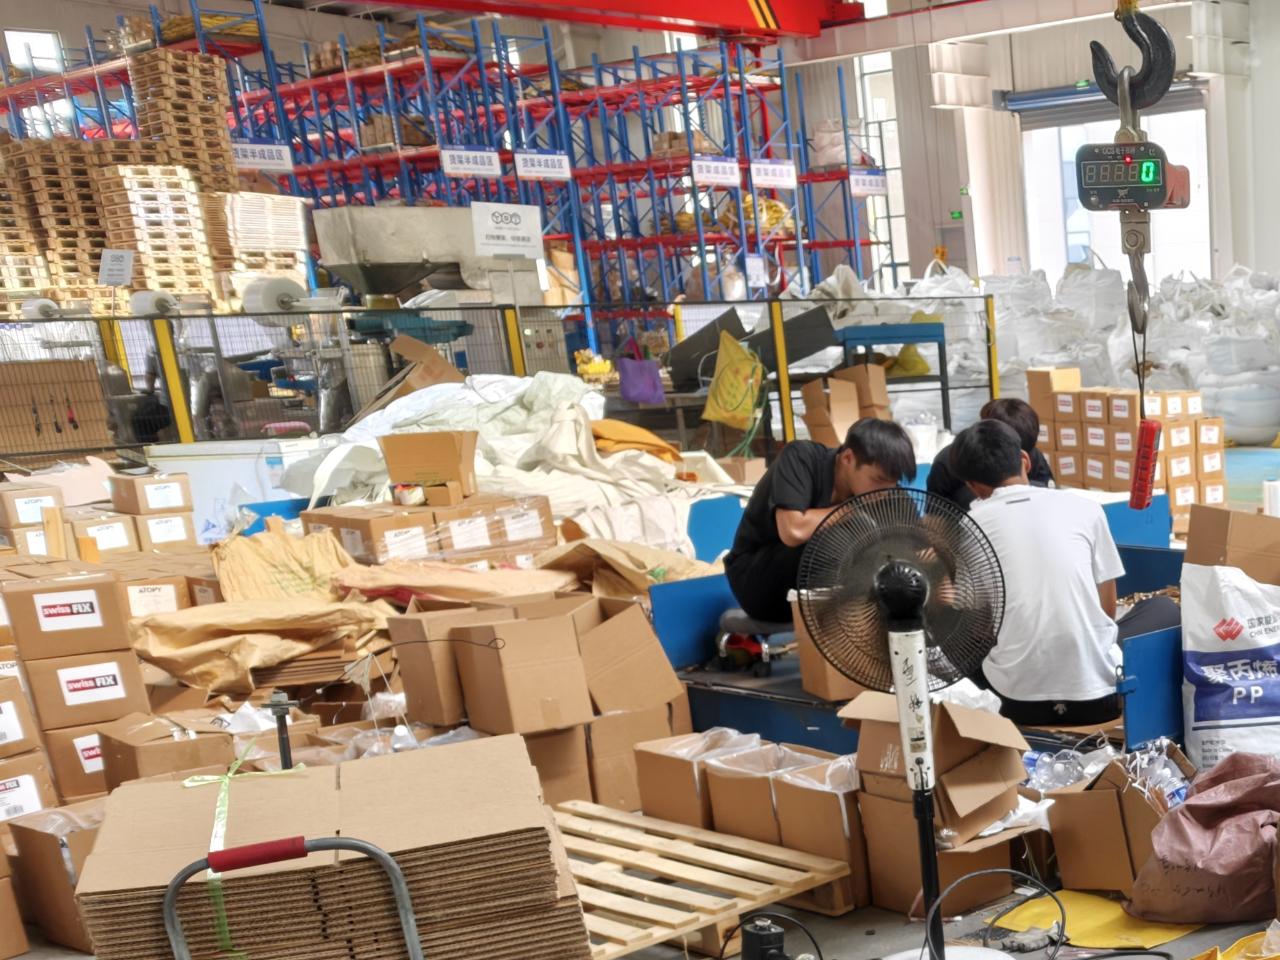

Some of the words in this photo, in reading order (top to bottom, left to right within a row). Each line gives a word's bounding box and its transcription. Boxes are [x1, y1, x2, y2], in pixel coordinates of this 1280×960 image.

[42, 604, 72, 617] swiss
[72, 602, 92, 614] FIX
[1200, 659, 1278, 684] 聚丙烯
[67, 679, 95, 692] swiss
[95, 675, 116, 687] FIX
[1232, 686, 1264, 705] PP
